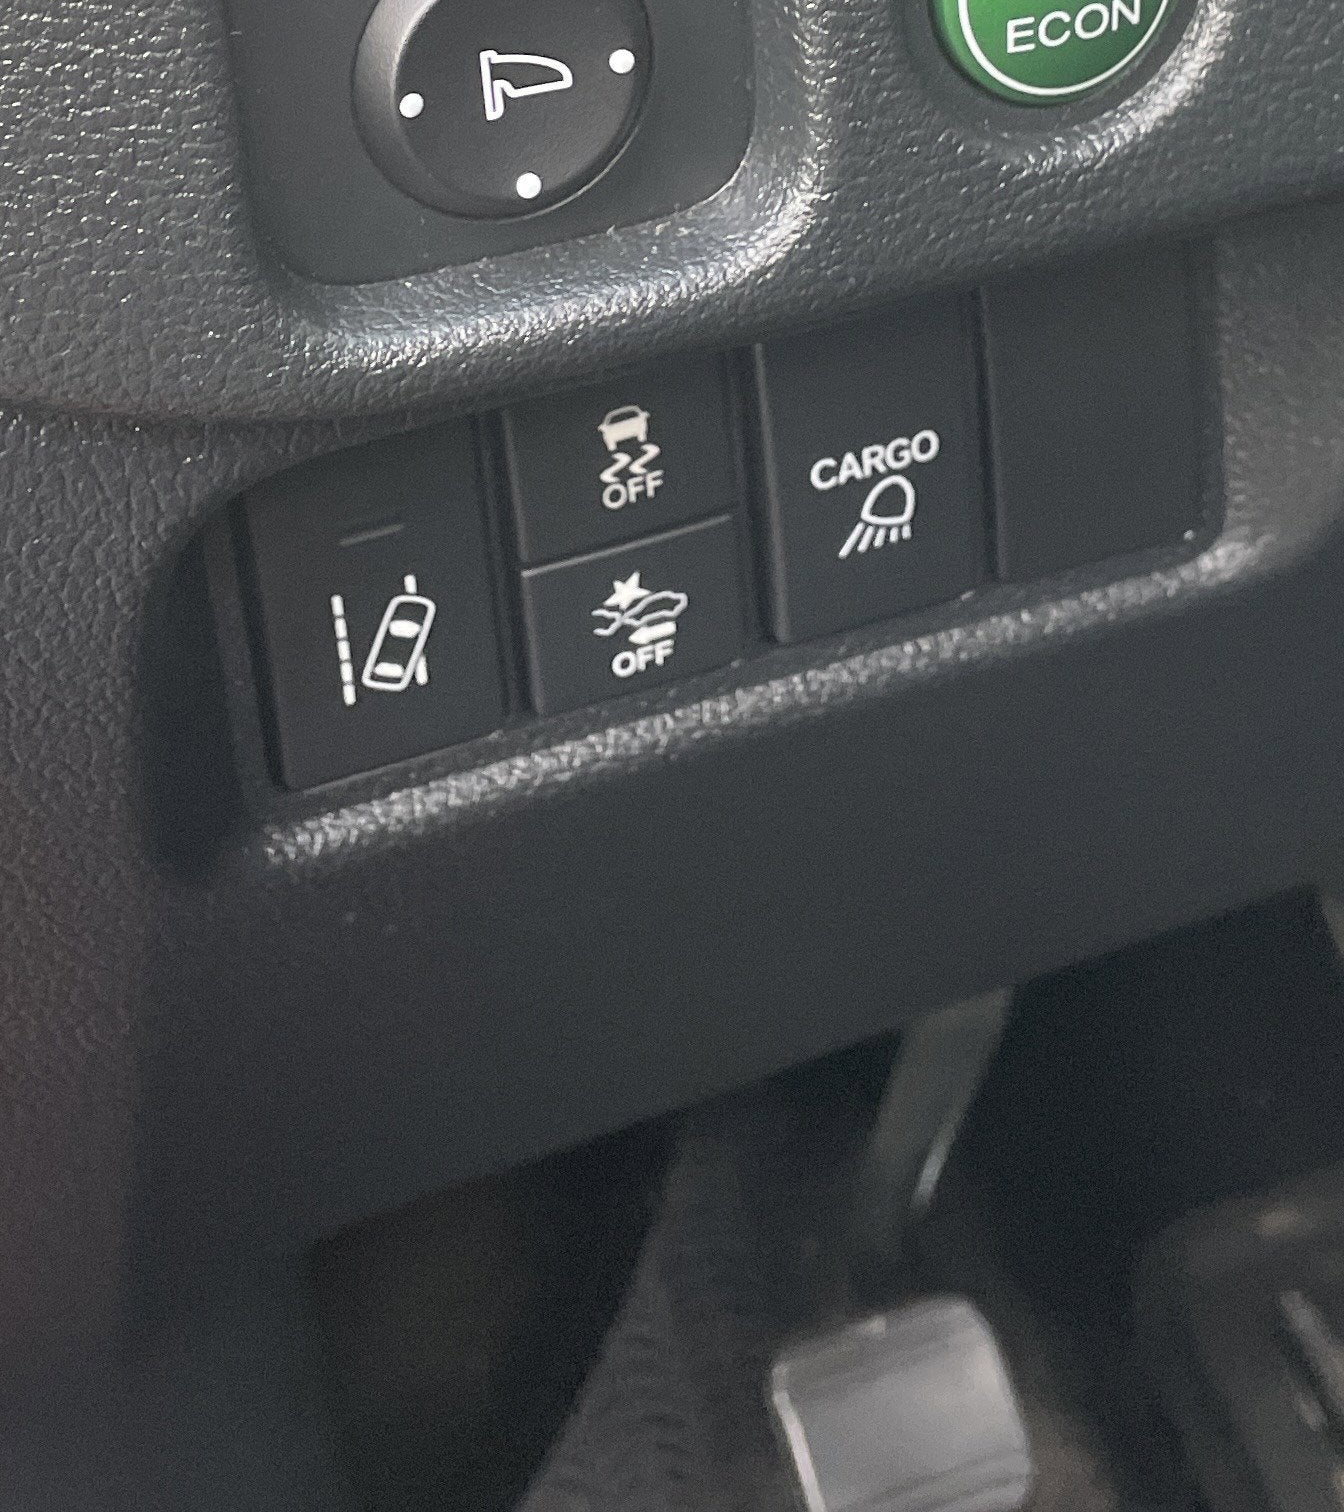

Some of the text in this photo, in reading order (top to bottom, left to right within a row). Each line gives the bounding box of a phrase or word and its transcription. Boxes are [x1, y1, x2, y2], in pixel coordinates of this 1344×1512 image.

[810, 429, 940, 491] CARGO
[601, 469, 665, 510] OFF
[611, 639, 675, 678] OFF
